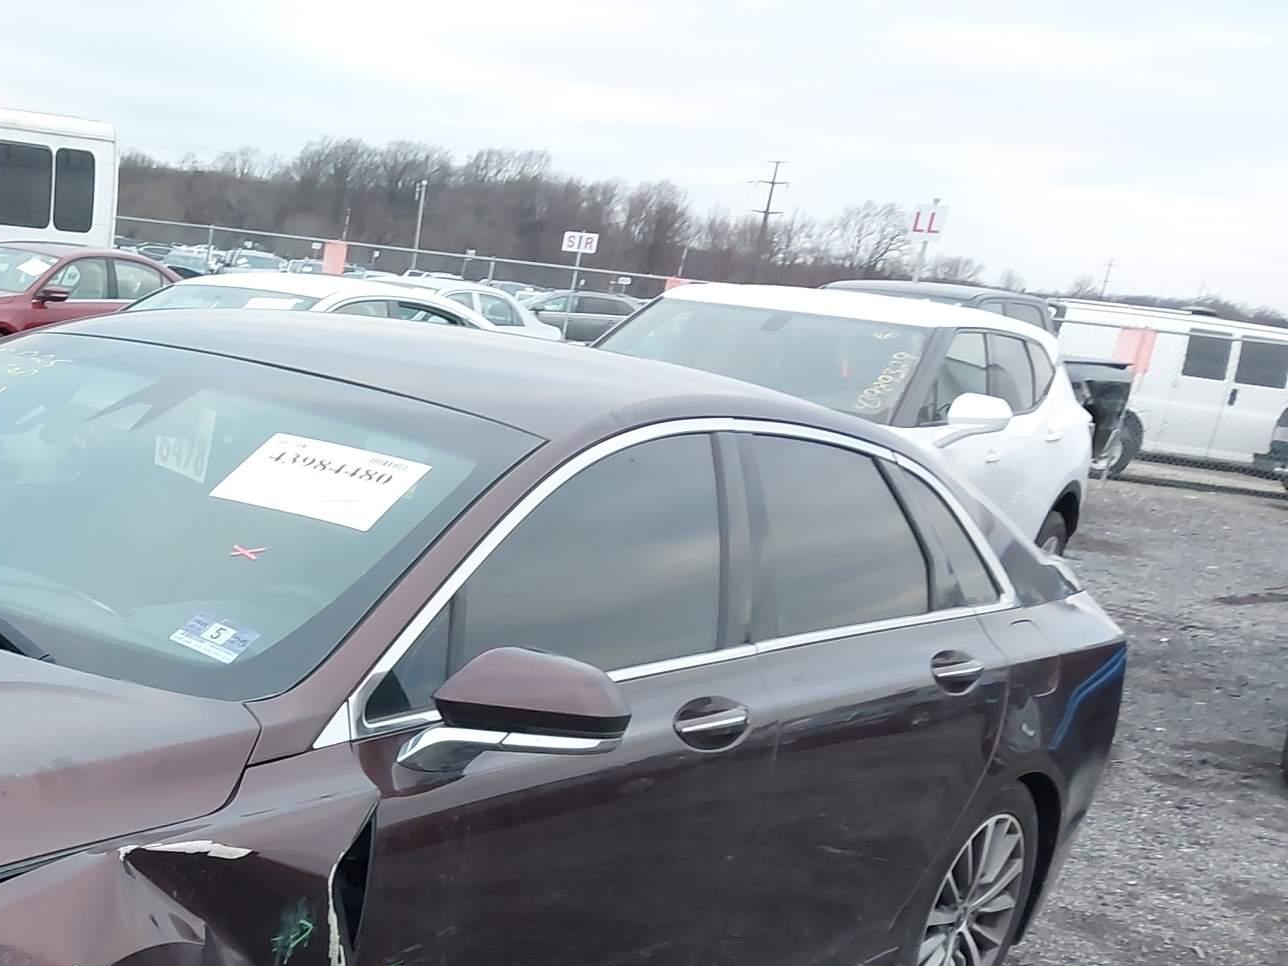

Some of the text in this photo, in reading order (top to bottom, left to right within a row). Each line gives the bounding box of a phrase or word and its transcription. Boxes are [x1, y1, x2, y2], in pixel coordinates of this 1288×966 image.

[911, 210, 941, 234] LL
[268, 451, 393, 485] 43984480
[209, 627, 226, 640] 5
